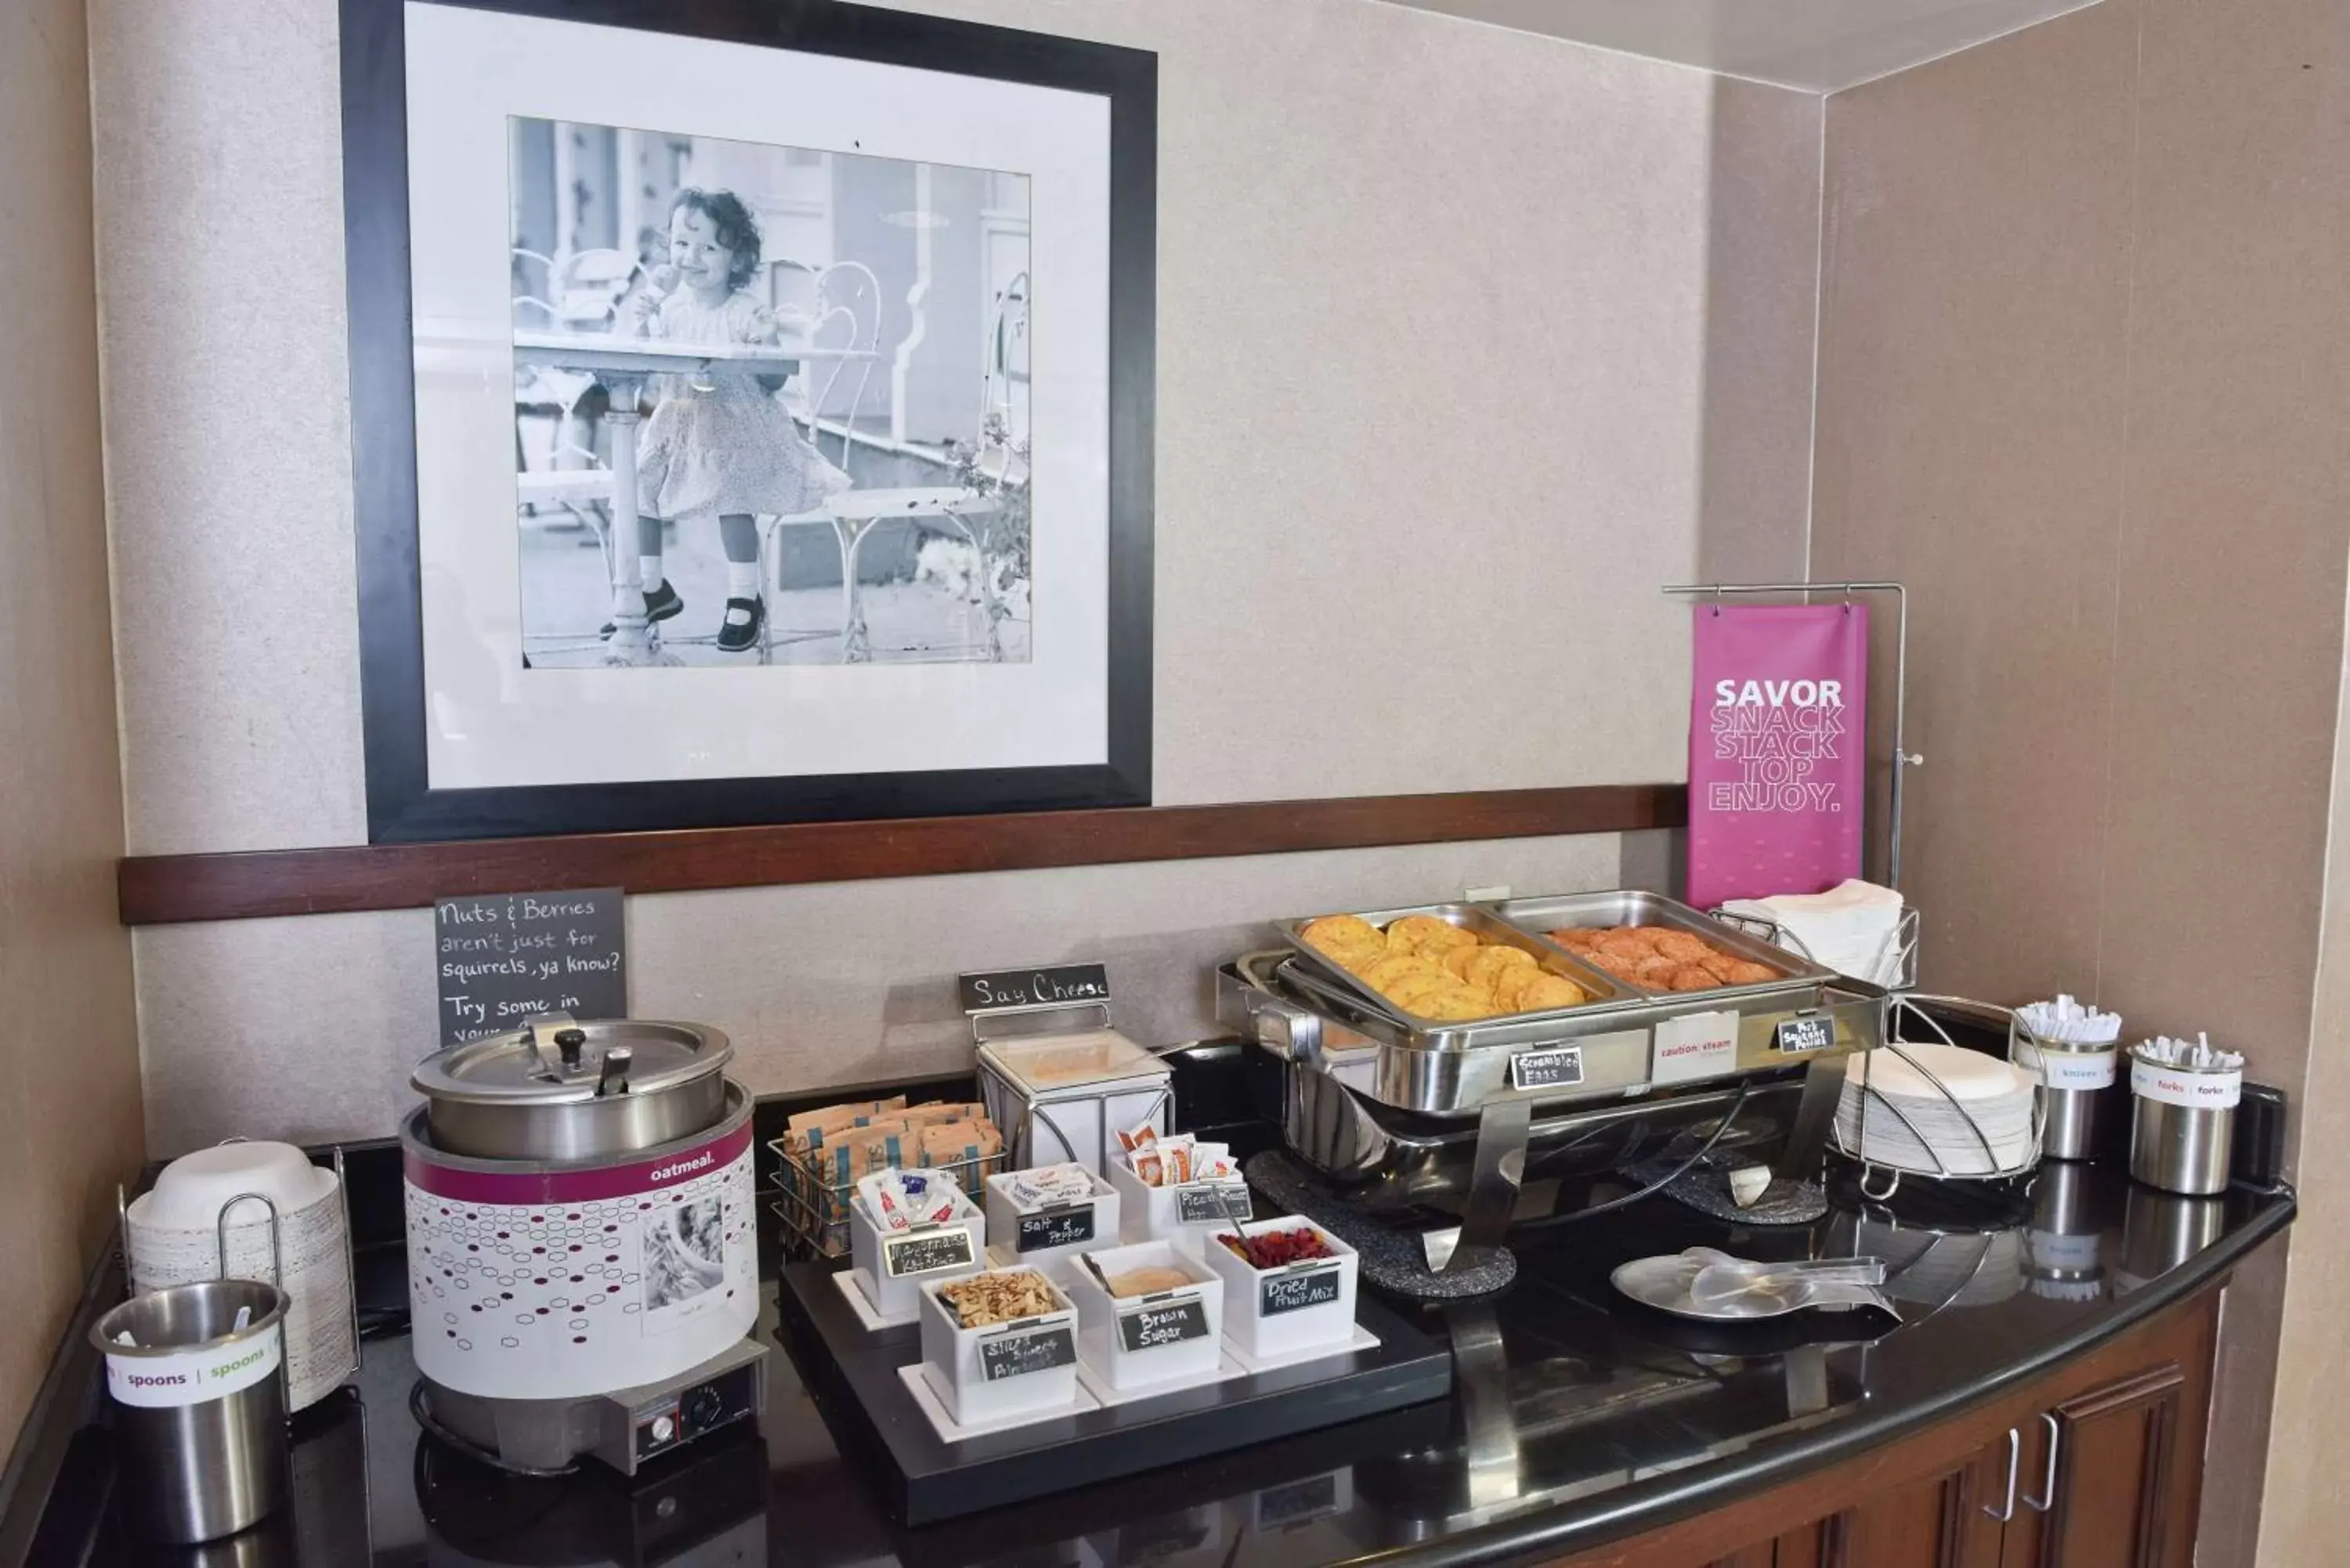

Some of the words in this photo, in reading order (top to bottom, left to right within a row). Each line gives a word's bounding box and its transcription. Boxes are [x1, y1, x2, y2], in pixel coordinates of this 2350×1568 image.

[1716, 680, 1842, 706] SAVOR
[1711, 705, 1846, 733] SNACK
[1715, 732, 1838, 759] STACK
[1739, 757, 1813, 785] TOP
[1709, 782, 1841, 811] ENJOY.
[439, 903, 497, 924] Nuts
[524, 898, 595, 919] Berries
[441, 933, 504, 952] aren't
[509, 932, 558, 953] just
[566, 929, 598, 947] for
[539, 961, 559, 980] ya
[566, 952, 620, 974] know?
[974, 979, 1028, 1004] Say
[1032, 974, 1108, 1002] Cheese
[444, 995, 486, 1024] Try
[497, 999, 551, 1017] some
[561, 994, 580, 1008] in
[2157, 1078, 2186, 1095] forks
[2196, 1085, 2224, 1097] forks
[651, 1151, 715, 1183] oatmeal.
[1268, 1277, 1307, 1298] Dried
[1274, 1292, 1307, 1307] Fruit
[1308, 1286, 1335, 1302] Mix
[1140, 1328, 1181, 1346] Sugar
[128, 1373, 186, 1388] spoons
[211, 1349, 265, 1378] spoons
